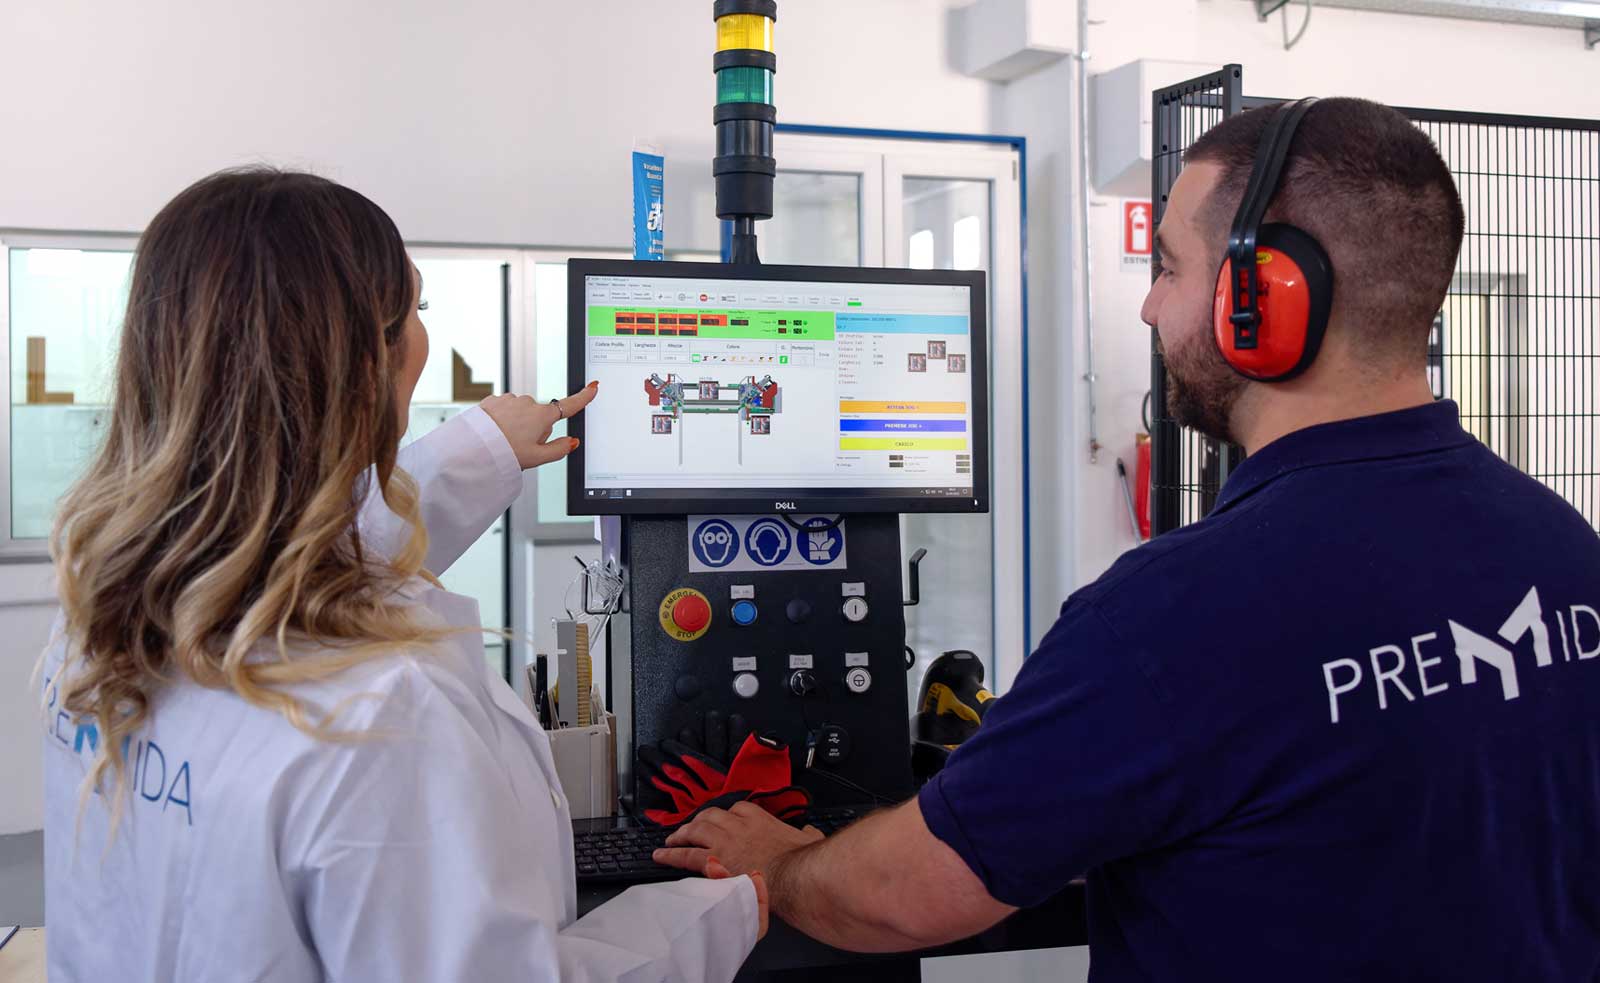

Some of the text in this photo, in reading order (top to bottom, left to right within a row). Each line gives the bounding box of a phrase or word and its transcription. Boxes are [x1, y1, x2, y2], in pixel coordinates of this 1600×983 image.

[1123, 256, 1151, 264] ESTIN
[775, 502, 796, 510] DELL
[664, 590, 697, 609] EMERGE
